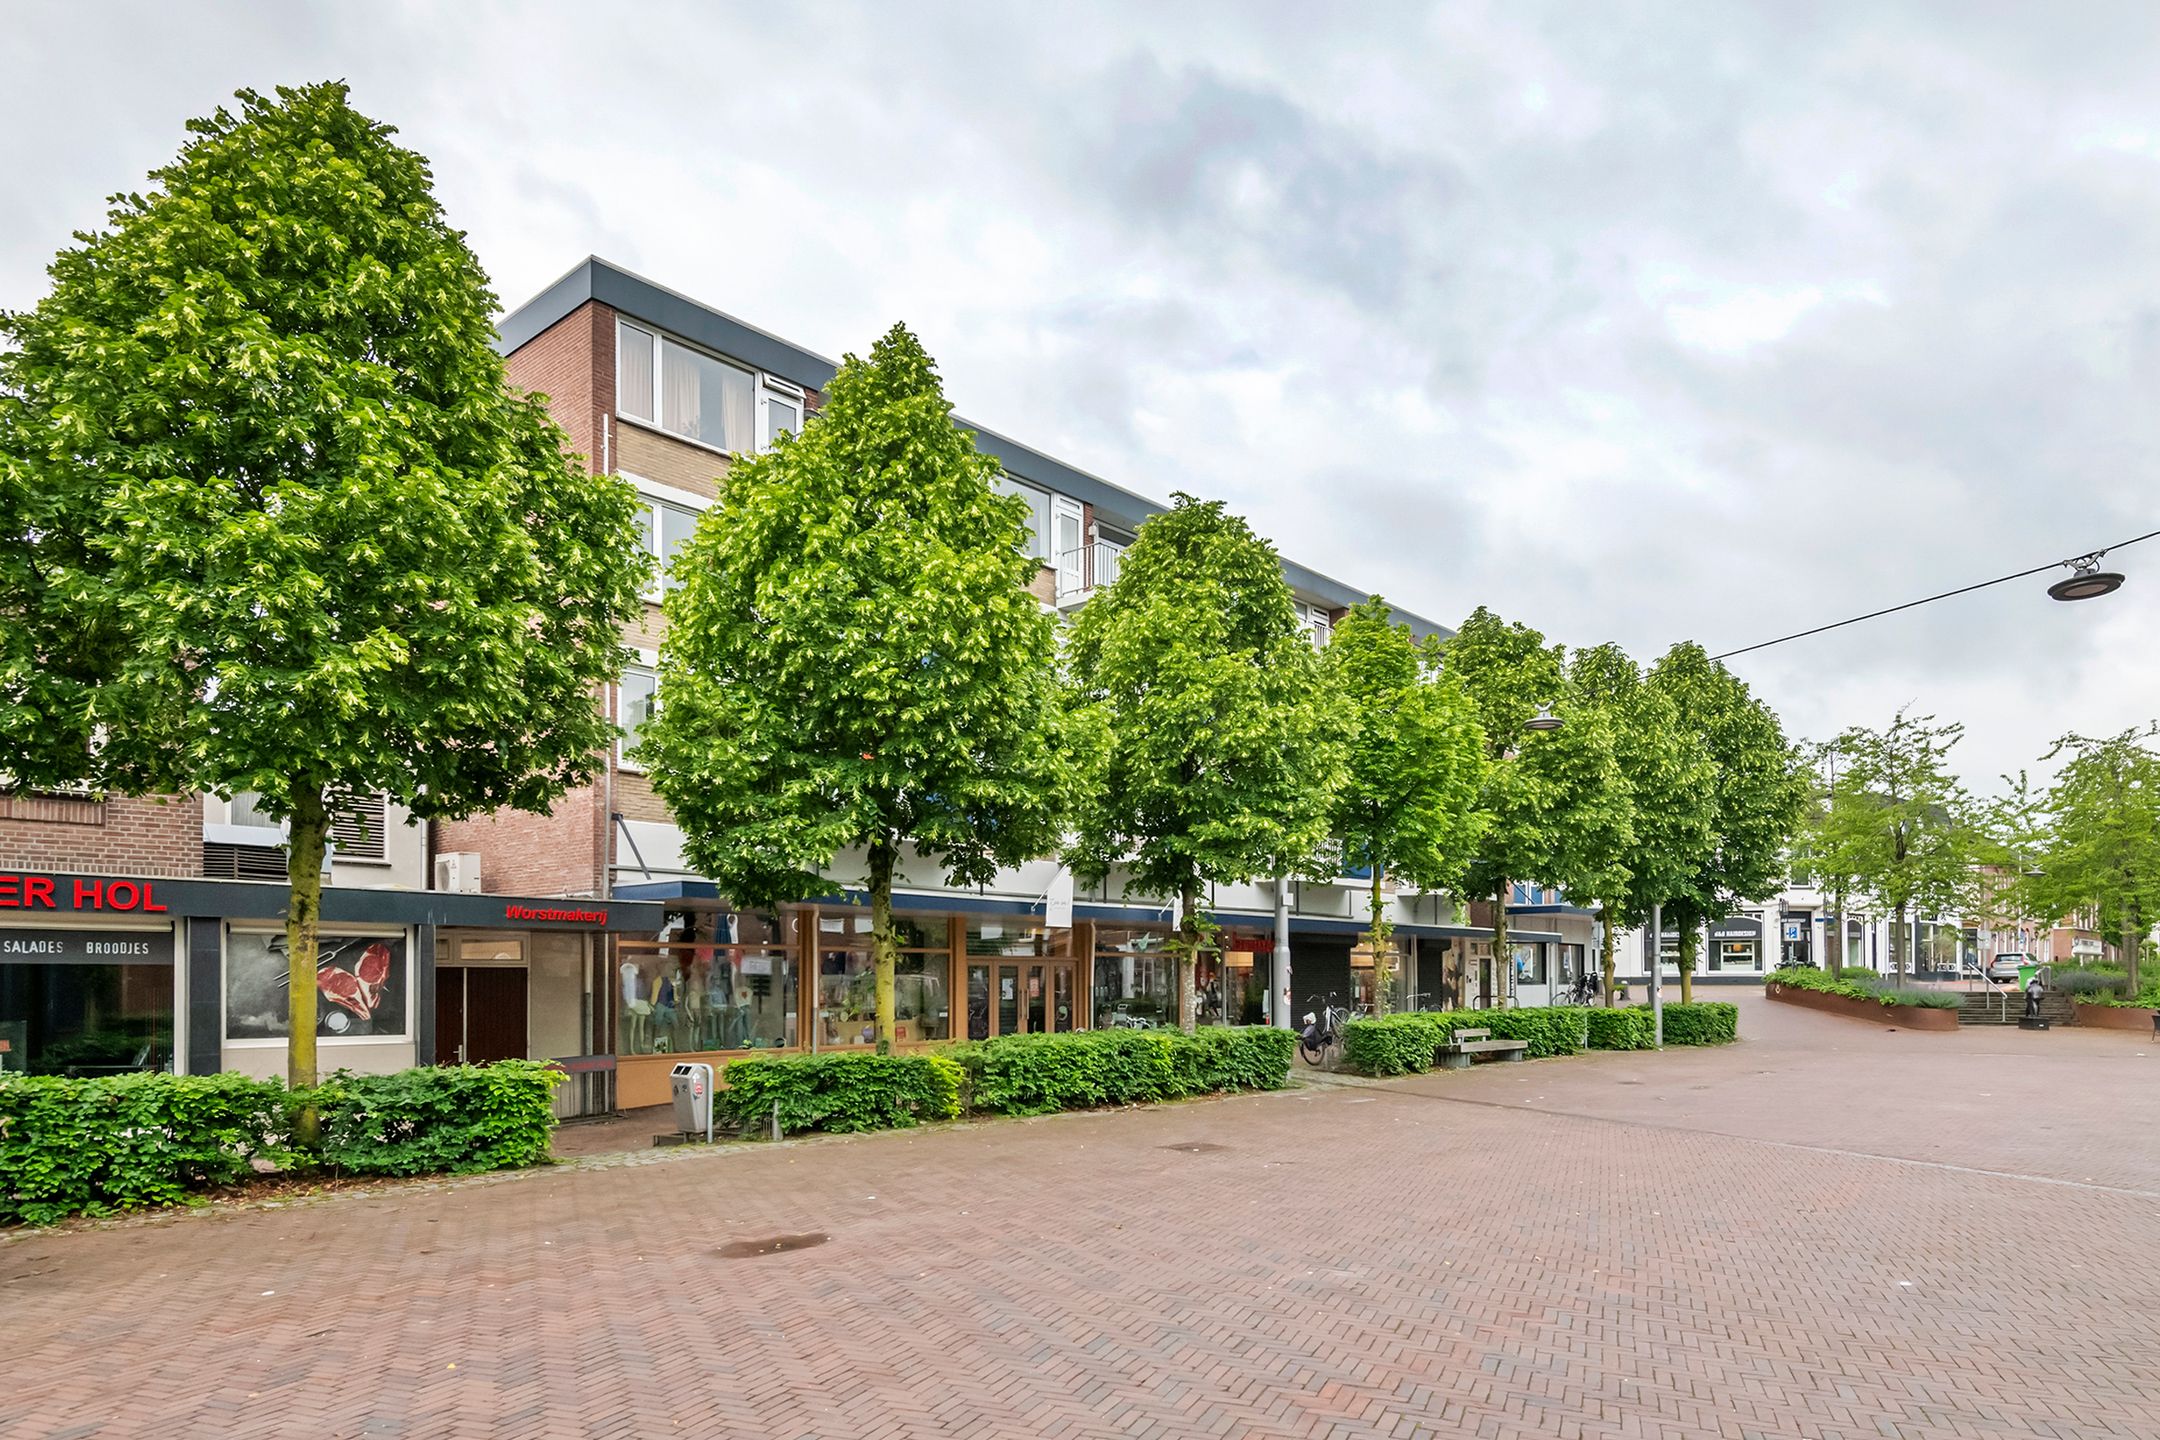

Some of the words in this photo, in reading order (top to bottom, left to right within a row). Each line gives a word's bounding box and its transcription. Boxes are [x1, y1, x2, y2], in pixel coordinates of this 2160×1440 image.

[73, 879, 168, 911] HOL
[506, 904, 608, 926] Worstmakerij
[4, 940, 64, 954] SALADES
[86, 941, 149, 955] BROODJES
